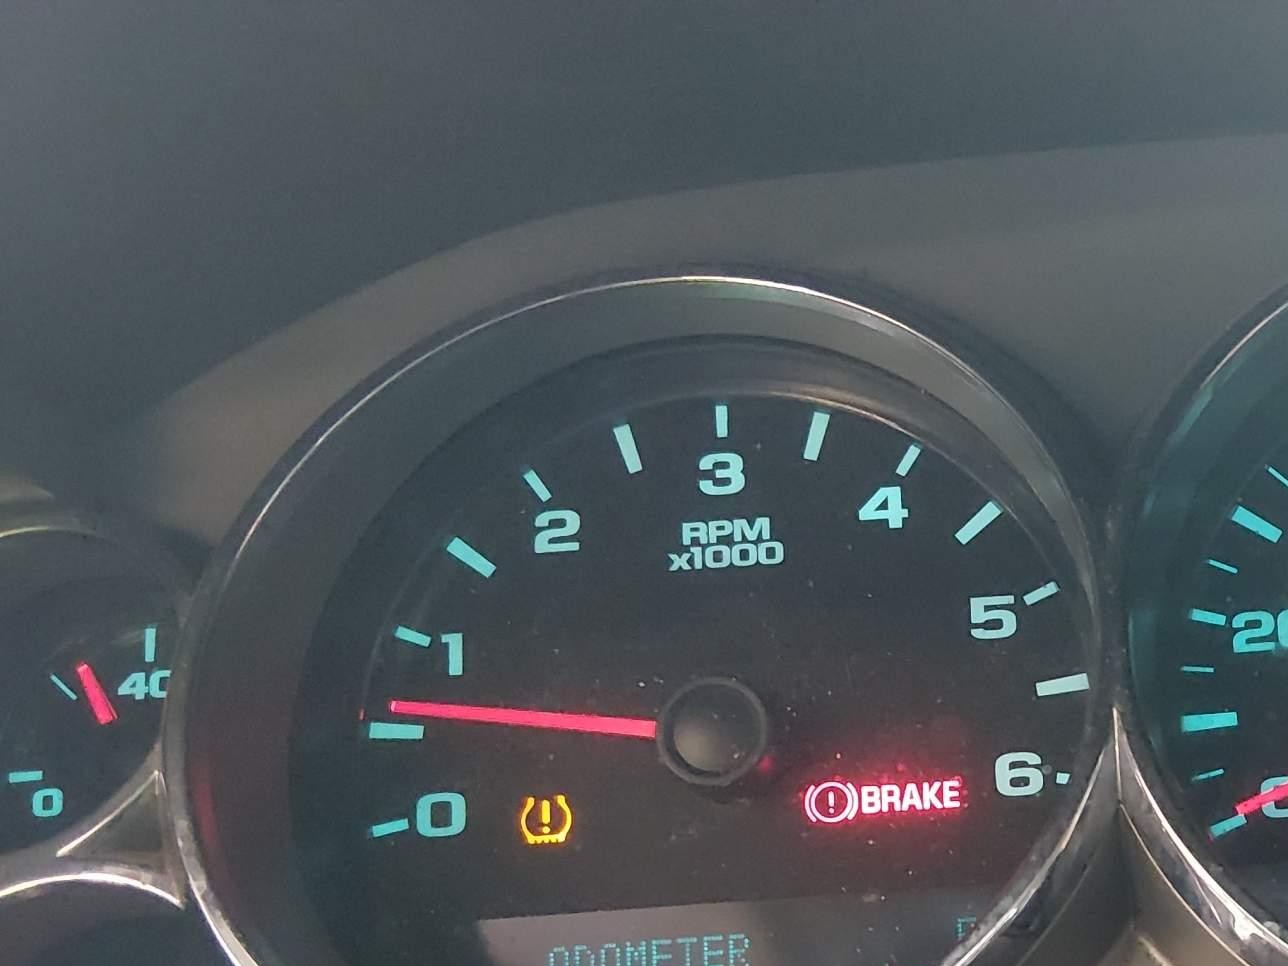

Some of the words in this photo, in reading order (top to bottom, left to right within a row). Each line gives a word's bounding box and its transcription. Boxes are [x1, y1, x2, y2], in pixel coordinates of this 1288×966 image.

[699, 452, 745, 495] 3
[858, 486, 908, 528] 4
[534, 510, 581, 554] 2
[681, 517, 771, 545] RPM
[668, 541, 784, 571] x1000
[969, 595, 1018, 639] 5
[441, 633, 463, 675] 1
[994, 752, 1044, 796] 6
[32, 789, 64, 817] 0
[416, 792, 466, 837] 0
[861, 780, 961, 814] BRAKE
